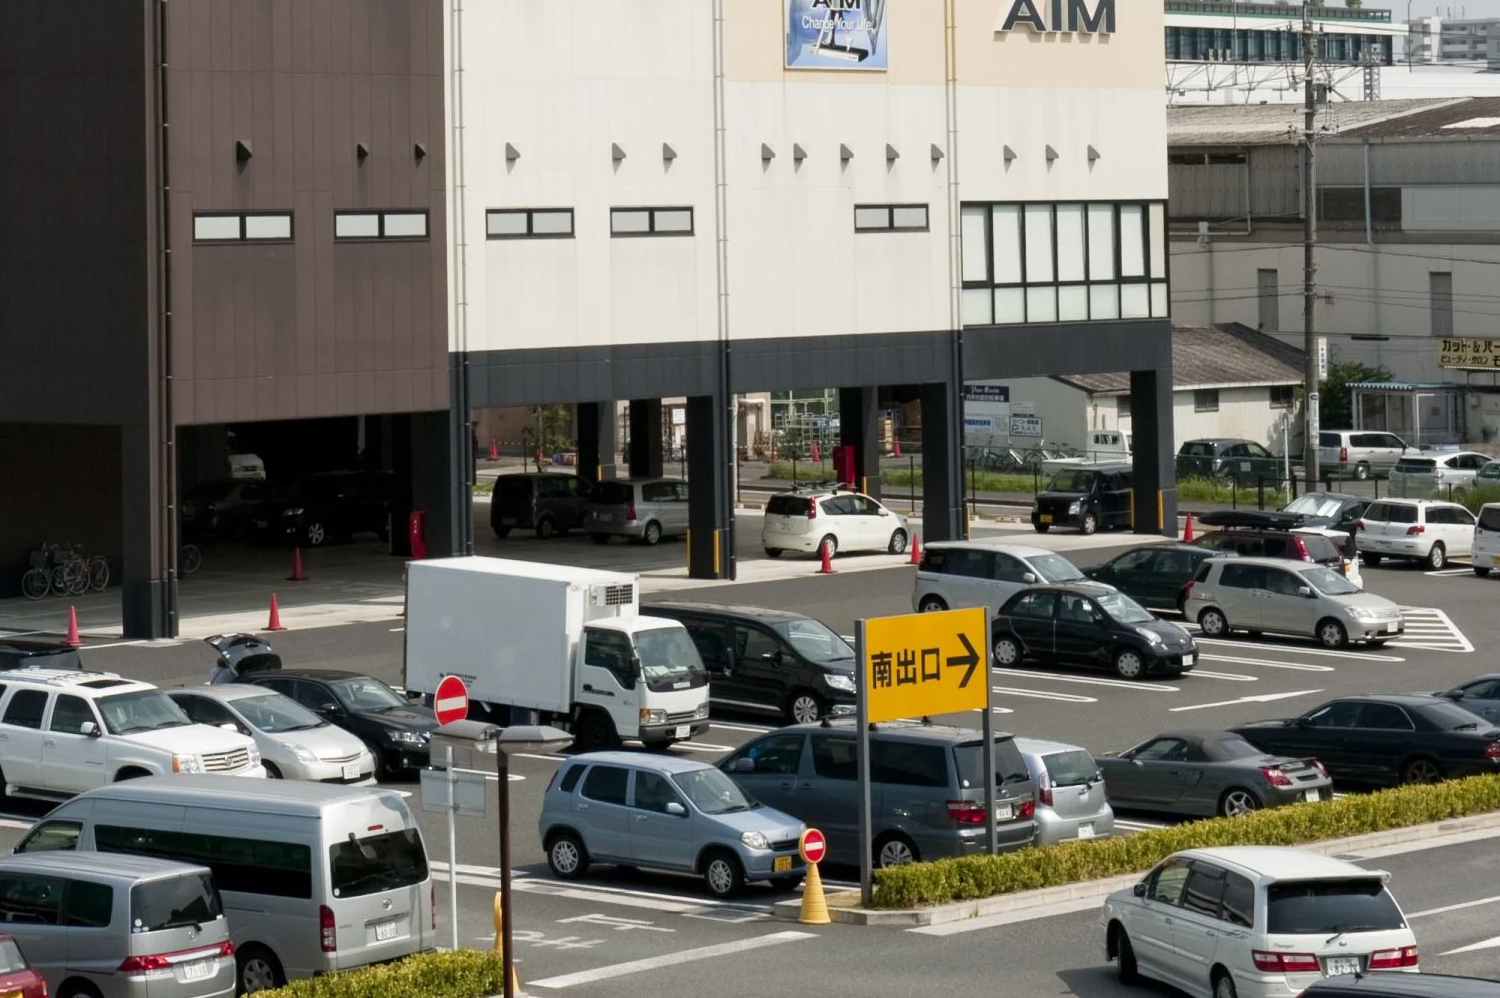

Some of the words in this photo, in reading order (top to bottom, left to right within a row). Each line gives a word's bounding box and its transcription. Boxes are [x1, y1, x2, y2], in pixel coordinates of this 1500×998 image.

[801, 15, 834, 33] Change
[834, 17, 854, 30] Your
[871, 647, 940, 689] 南出口
